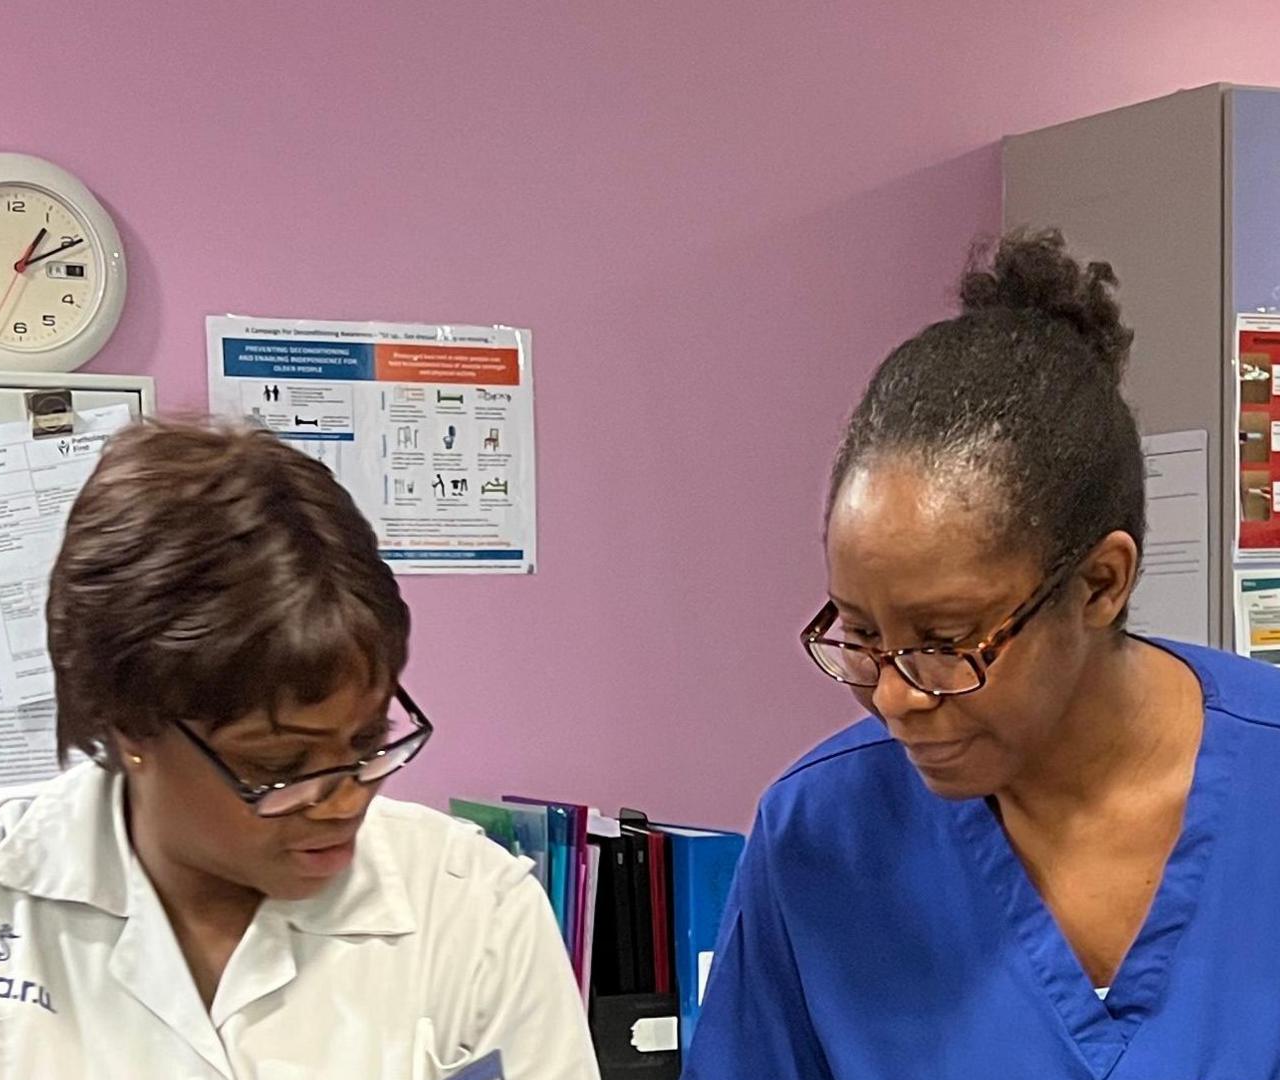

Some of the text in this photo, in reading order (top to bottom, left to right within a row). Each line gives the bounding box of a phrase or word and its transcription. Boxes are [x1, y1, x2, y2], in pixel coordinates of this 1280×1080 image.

[7, 201, 26, 213] 12
[45, 212, 49, 224] 1
[62, 294, 75, 305] 4
[42, 315, 56, 327] 5
[13, 322, 28, 334] 6
[245, 345, 350, 356] PREVENTING DECONDITIONING
[255, 355, 289, 363] ENABLING
[290, 356, 342, 364] INDEPENDENCE
